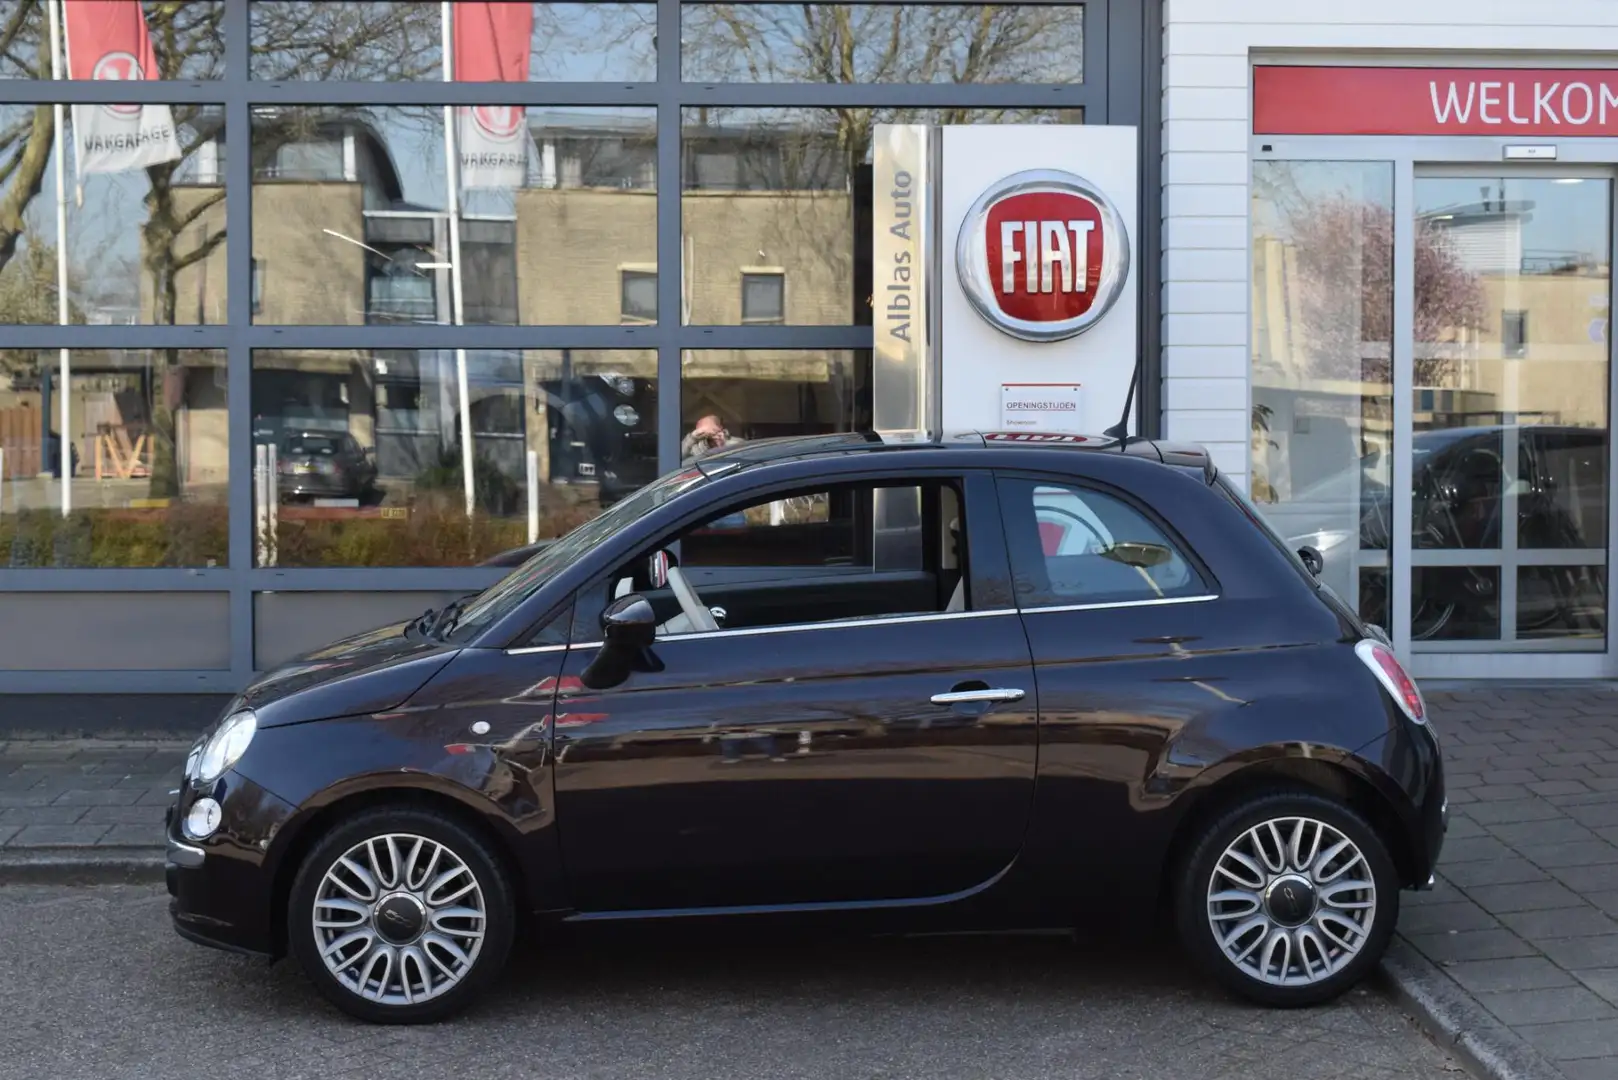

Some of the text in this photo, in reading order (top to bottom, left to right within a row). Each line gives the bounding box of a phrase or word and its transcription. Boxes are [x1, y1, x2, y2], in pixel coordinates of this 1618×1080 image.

[887, 170, 912, 343] Alblas Auto
[1000, 220, 1095, 293] FIAT
